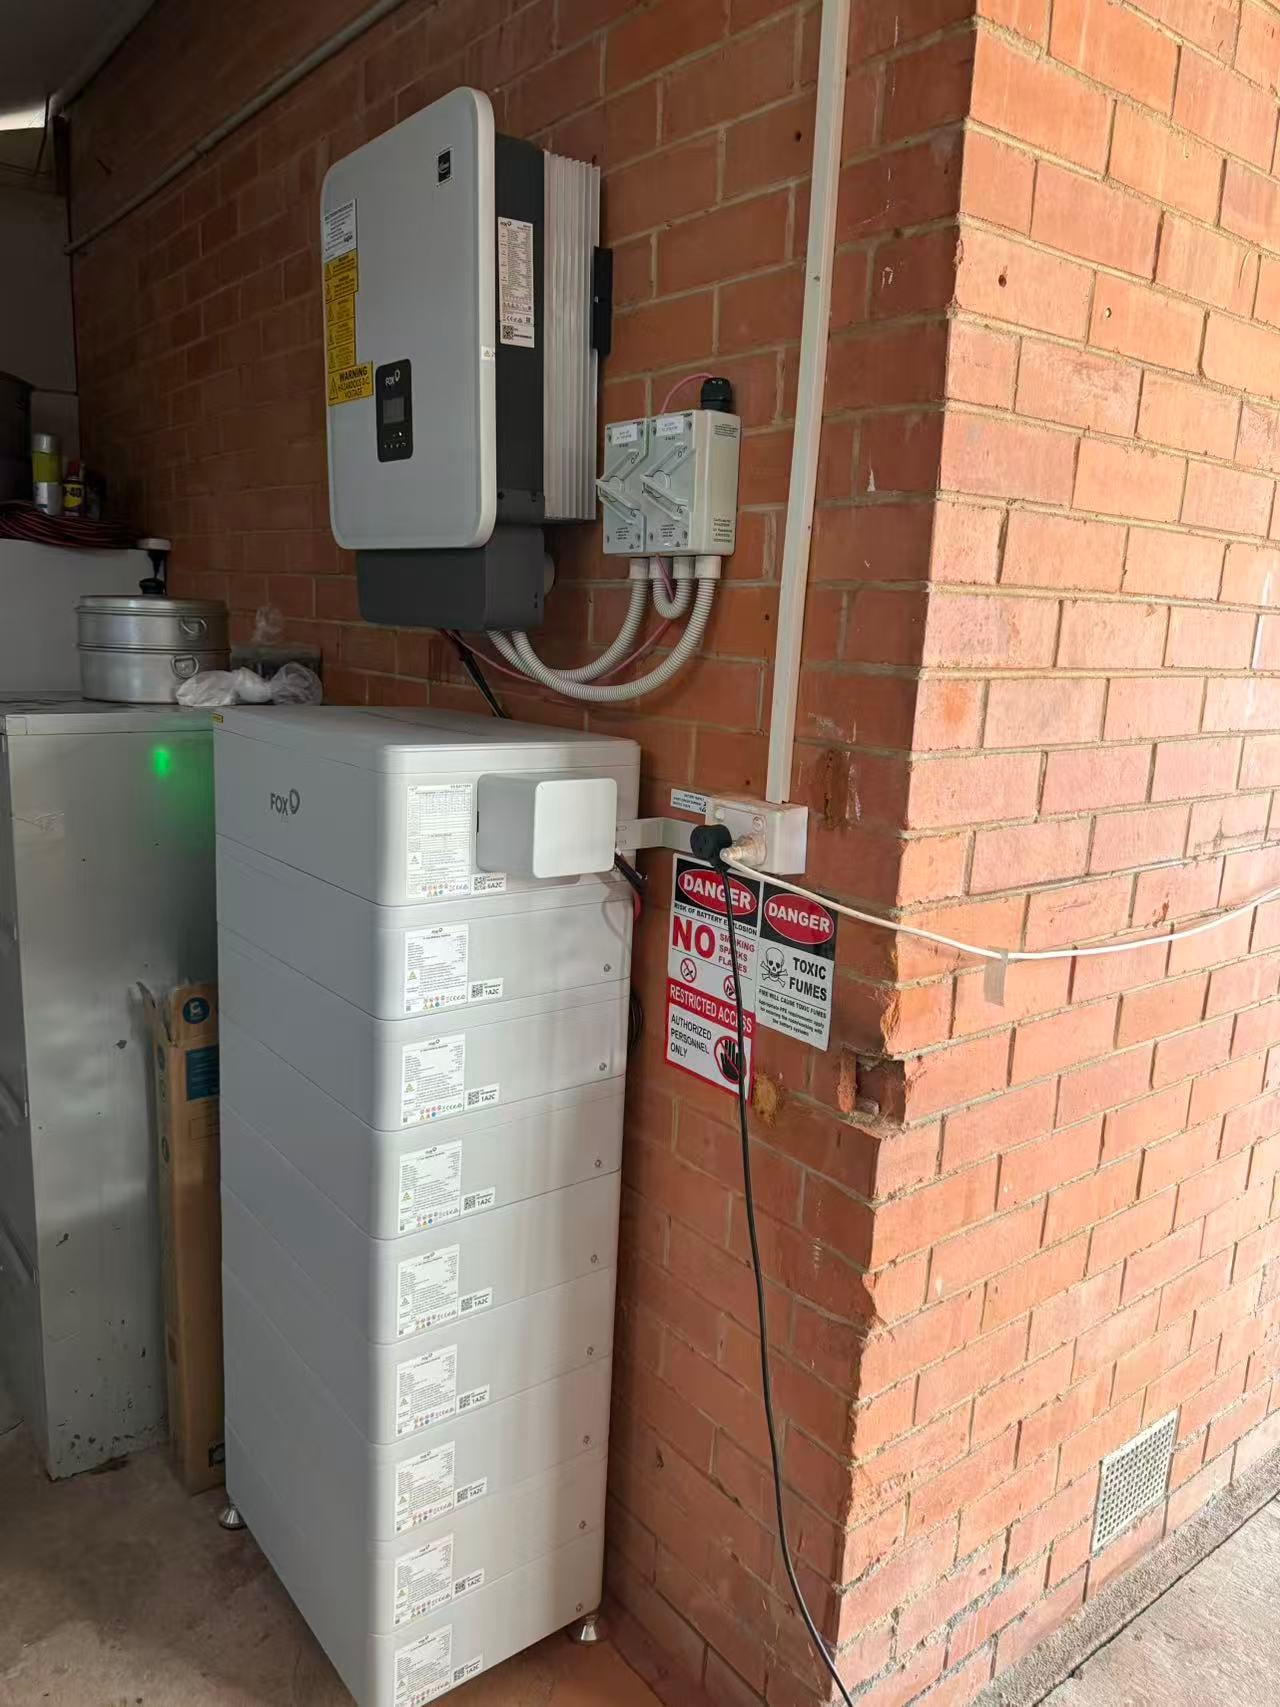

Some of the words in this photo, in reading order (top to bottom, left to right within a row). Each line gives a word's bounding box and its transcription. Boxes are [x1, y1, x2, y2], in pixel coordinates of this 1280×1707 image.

[339, 366, 368, 382] WARNING
[344, 387, 363, 399] VOLTAGE
[270, 792, 289, 816] FOX
[683, 873, 752, 911] DANGER
[674, 902, 687, 913] RISK
[687, 905, 696, 914] OF
[696, 908, 723, 924] BATTERY
[768, 902, 831, 933] DANGER
[672, 915, 716, 960] NO
[720, 933, 756, 953] SMKING
[718, 955, 748, 974] FLAES
[792, 957, 827, 980] TOXIC
[670, 984, 717, 1017] RESTRICTED
[789, 977, 828, 1001] FUMES
[769, 993, 780, 1002] WILL
[780, 997, 796, 1008] CAUSE
[796, 1002, 810, 1013] TOXIC
[810, 1008, 827, 1019] FUMES
[779, 1006, 788, 1014] PPE
[671, 1013, 712, 1041] AUTHORIZED
[670, 1028, 710, 1055] PERSONNEL
[670, 1042, 688, 1059] ONLY
[481, 1093, 496, 1102] 1A2C
